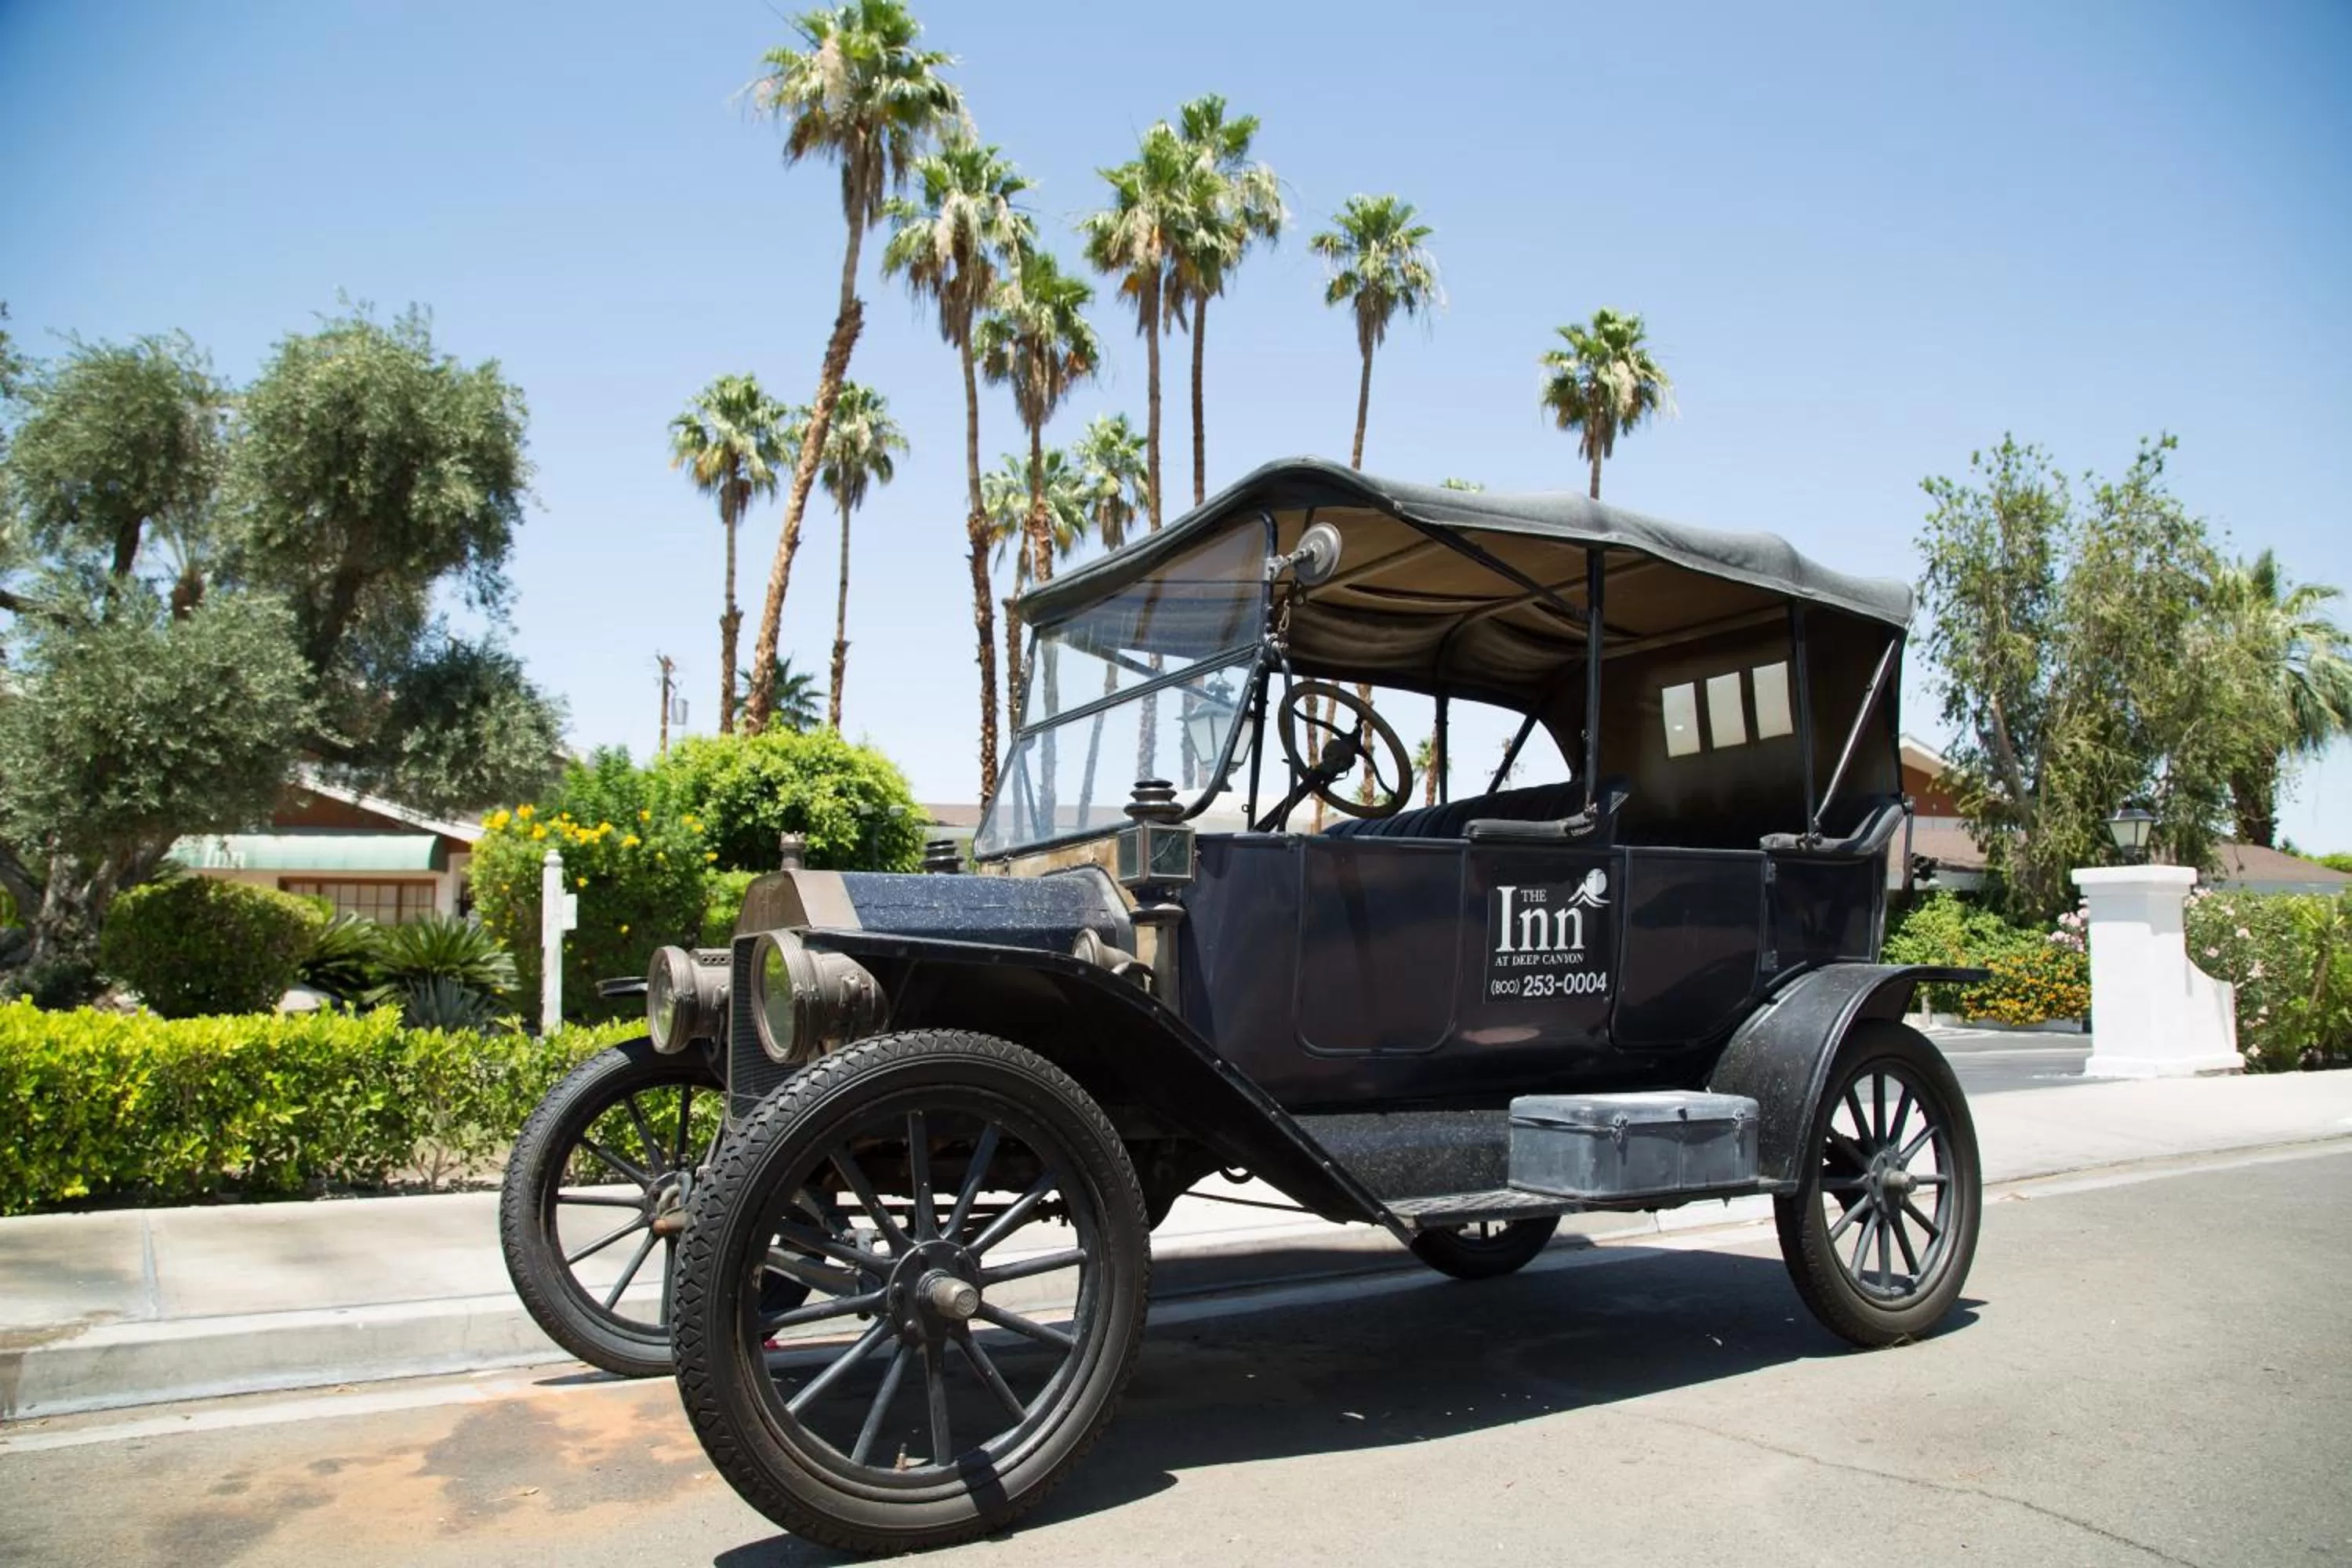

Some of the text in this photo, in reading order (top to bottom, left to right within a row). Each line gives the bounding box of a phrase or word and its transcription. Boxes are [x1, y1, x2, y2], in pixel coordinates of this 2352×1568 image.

[1520, 889, 1547, 902] THE
[1495, 886, 1585, 952] Inn
[1495, 953, 1584, 967] AT DEEP CANYON
[1490, 972, 1607, 996] (800) 253-0004
